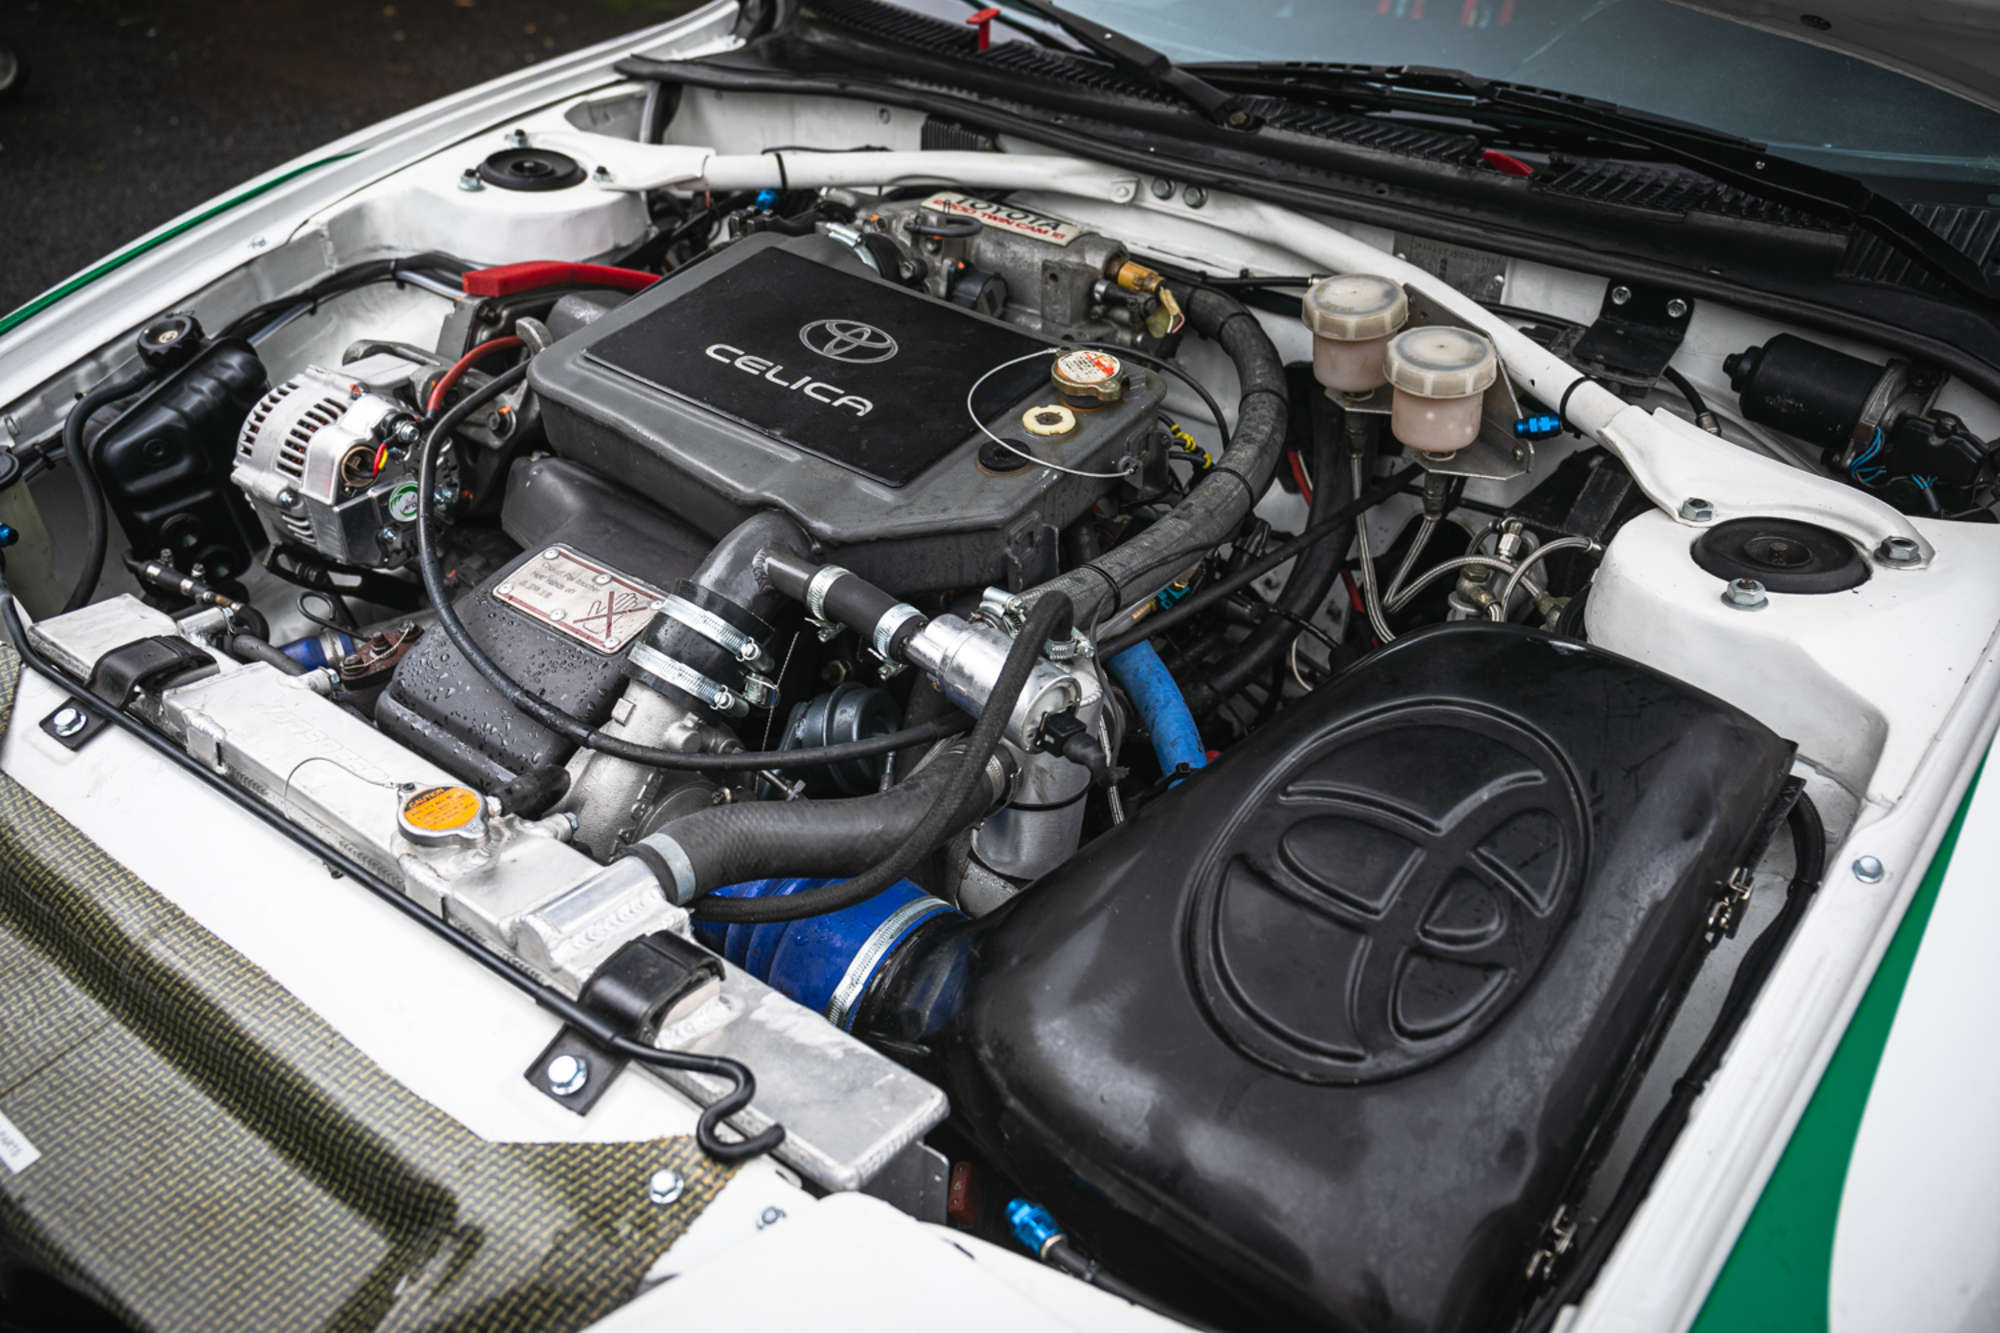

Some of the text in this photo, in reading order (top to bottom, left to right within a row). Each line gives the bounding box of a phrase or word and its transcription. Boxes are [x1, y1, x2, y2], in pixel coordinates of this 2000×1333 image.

[957, 198, 1061, 231] TOYOTA
[981, 211, 1014, 225] TWIN
[1015, 222, 1049, 235] CAM
[705, 343, 873, 416] CELICA
